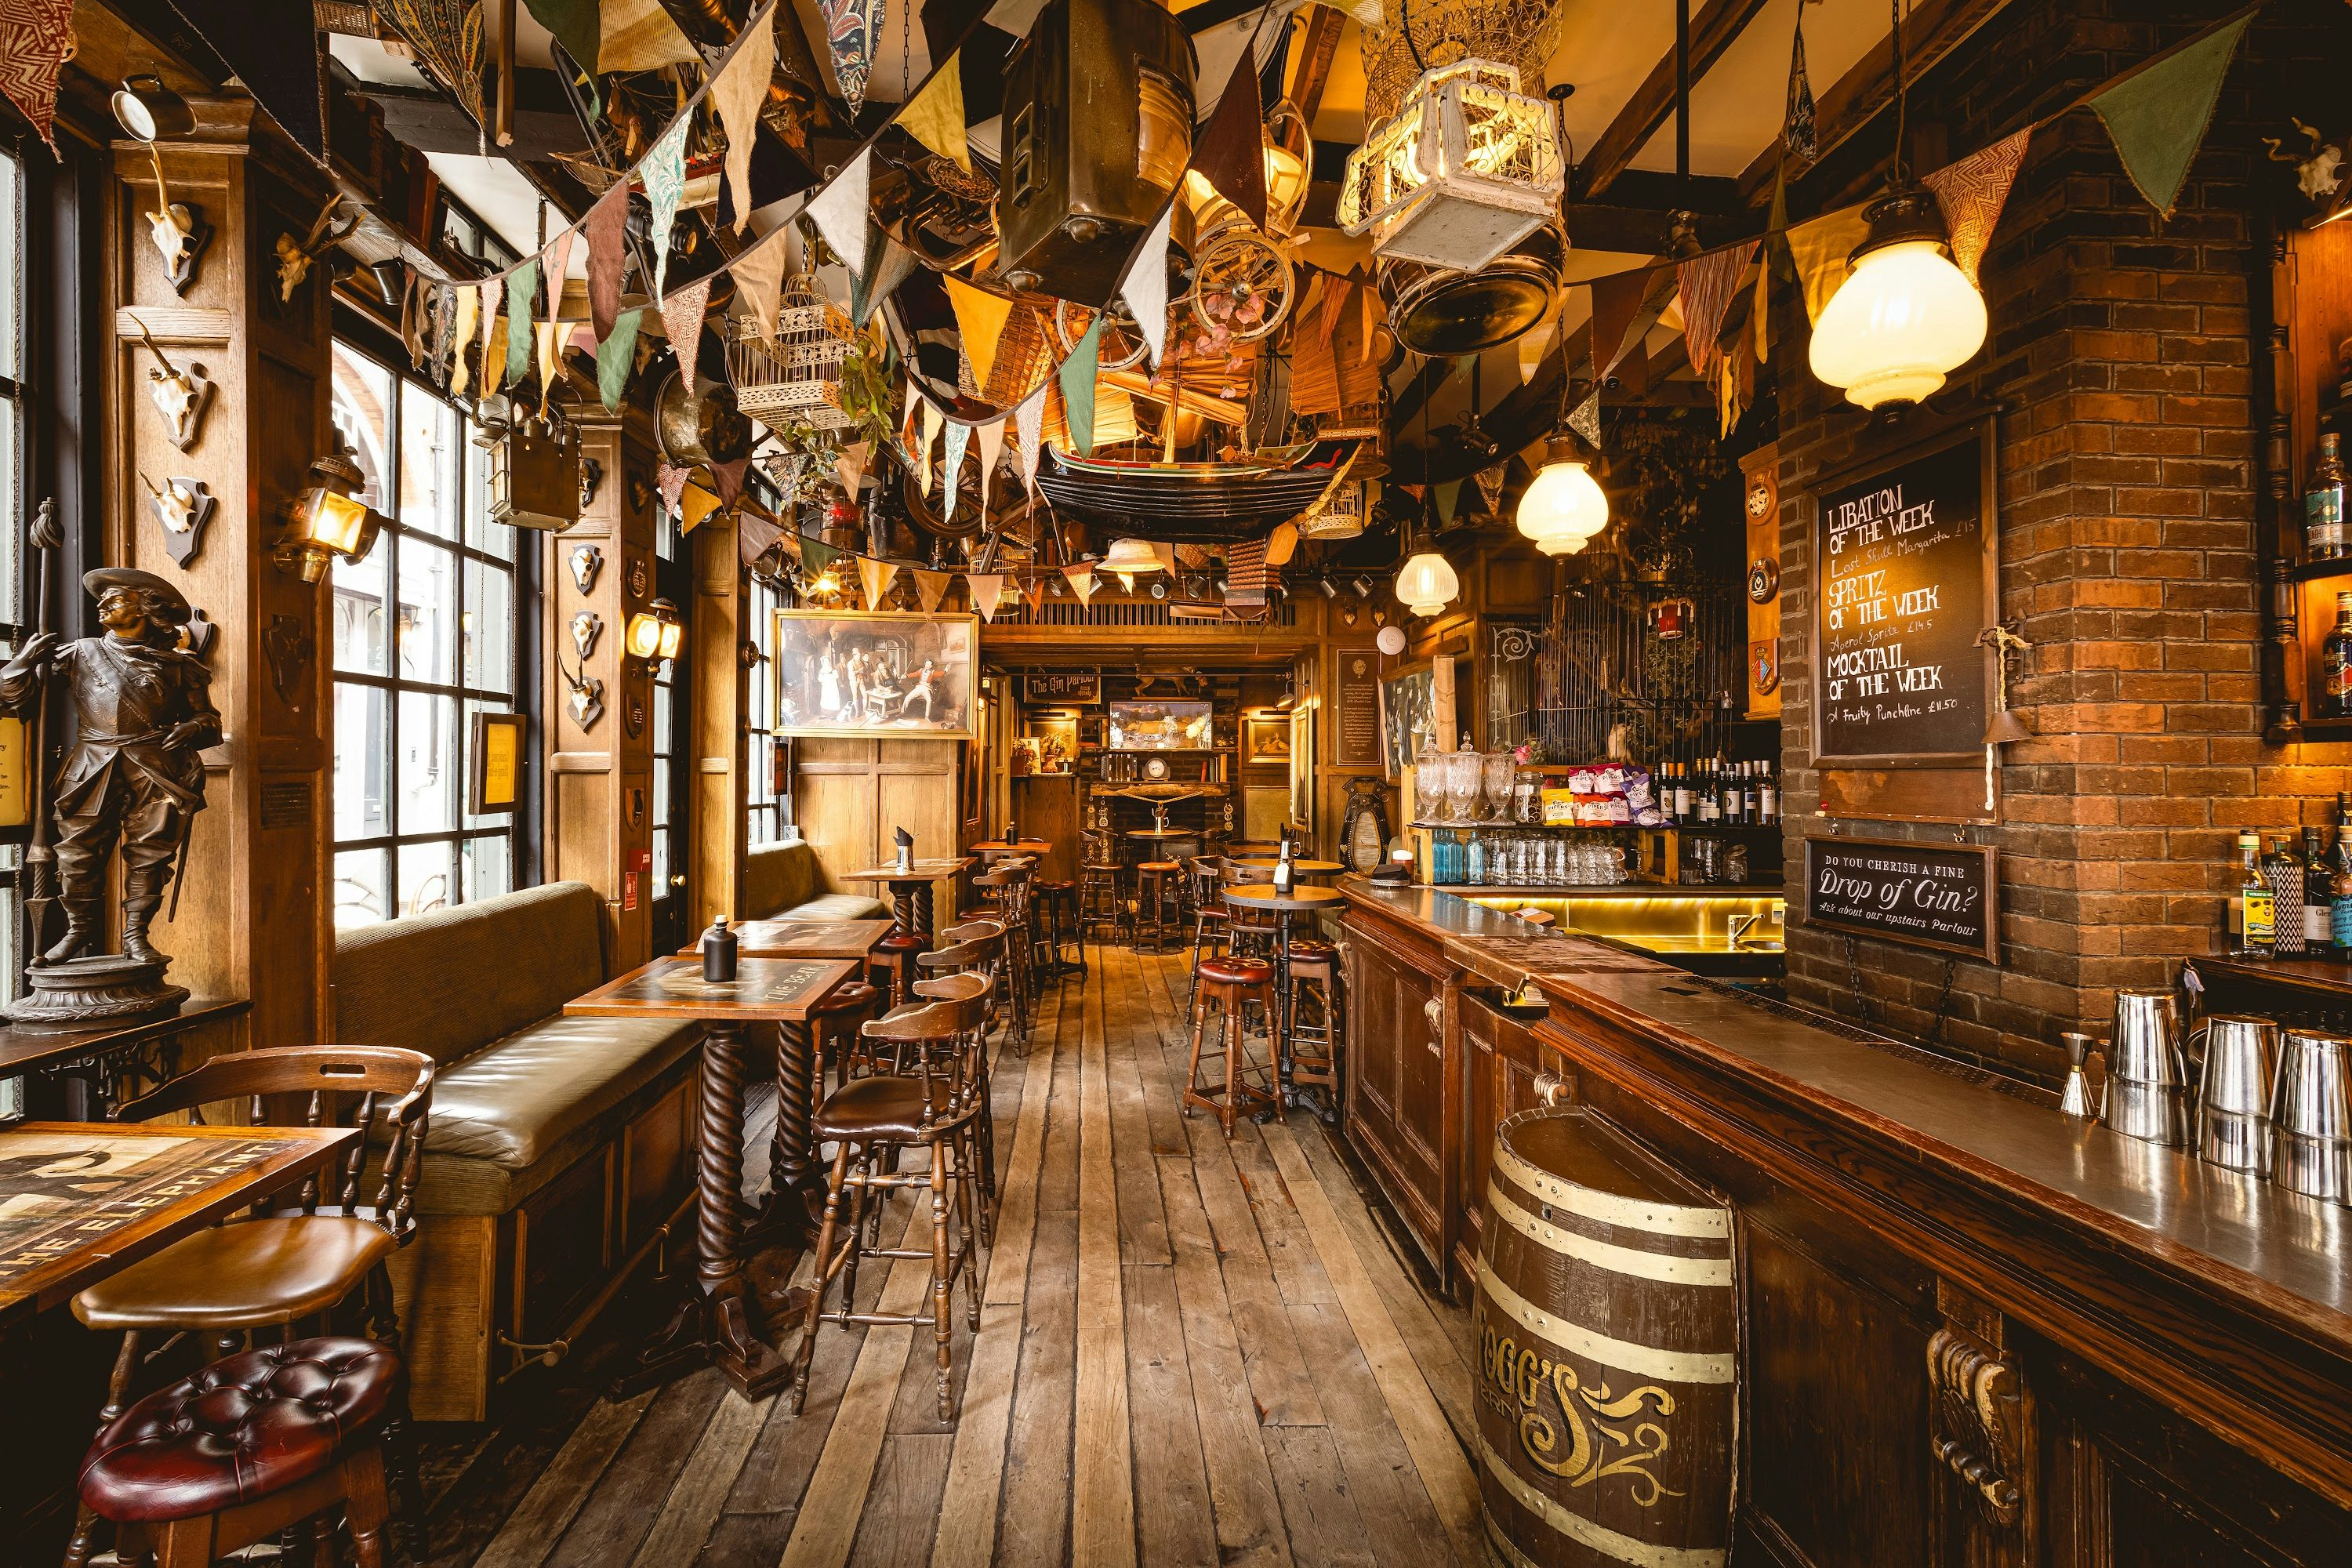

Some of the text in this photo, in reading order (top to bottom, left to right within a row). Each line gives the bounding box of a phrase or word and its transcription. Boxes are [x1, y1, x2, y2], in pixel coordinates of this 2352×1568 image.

[1827, 484, 1903, 534] LIBATION
[1829, 499, 1935, 555] OF THE WEEK
[1831, 554, 1860, 579] Lost
[1897, 530, 1951, 557] Margarita
[1828, 569, 1887, 608] SPRITZ
[1829, 584, 1941, 630] OF THE WEEK
[1827, 643, 1910, 678] MOCKTAIL
[1829, 632, 1864, 654] Aperol
[1031, 680, 1047, 694] The
[1050, 676, 1064, 694] Gin
[1828, 665, 1944, 701] OF THE WEEK
[1842, 706, 1871, 725] Fruity
[1876, 703, 1922, 720] Punchline
[1927, 699, 1958, 713] £11.50
[1825, 855, 1965, 879] DO YOU CHERISH A FINE
[1817, 867, 1978, 913] Drop of Gin?
[1819, 902, 1977, 936] Ask about our upstairs Parlour
[763, 964, 829, 1000] THE BEAR
[74, 1144, 277, 1231] ELEPHANT
